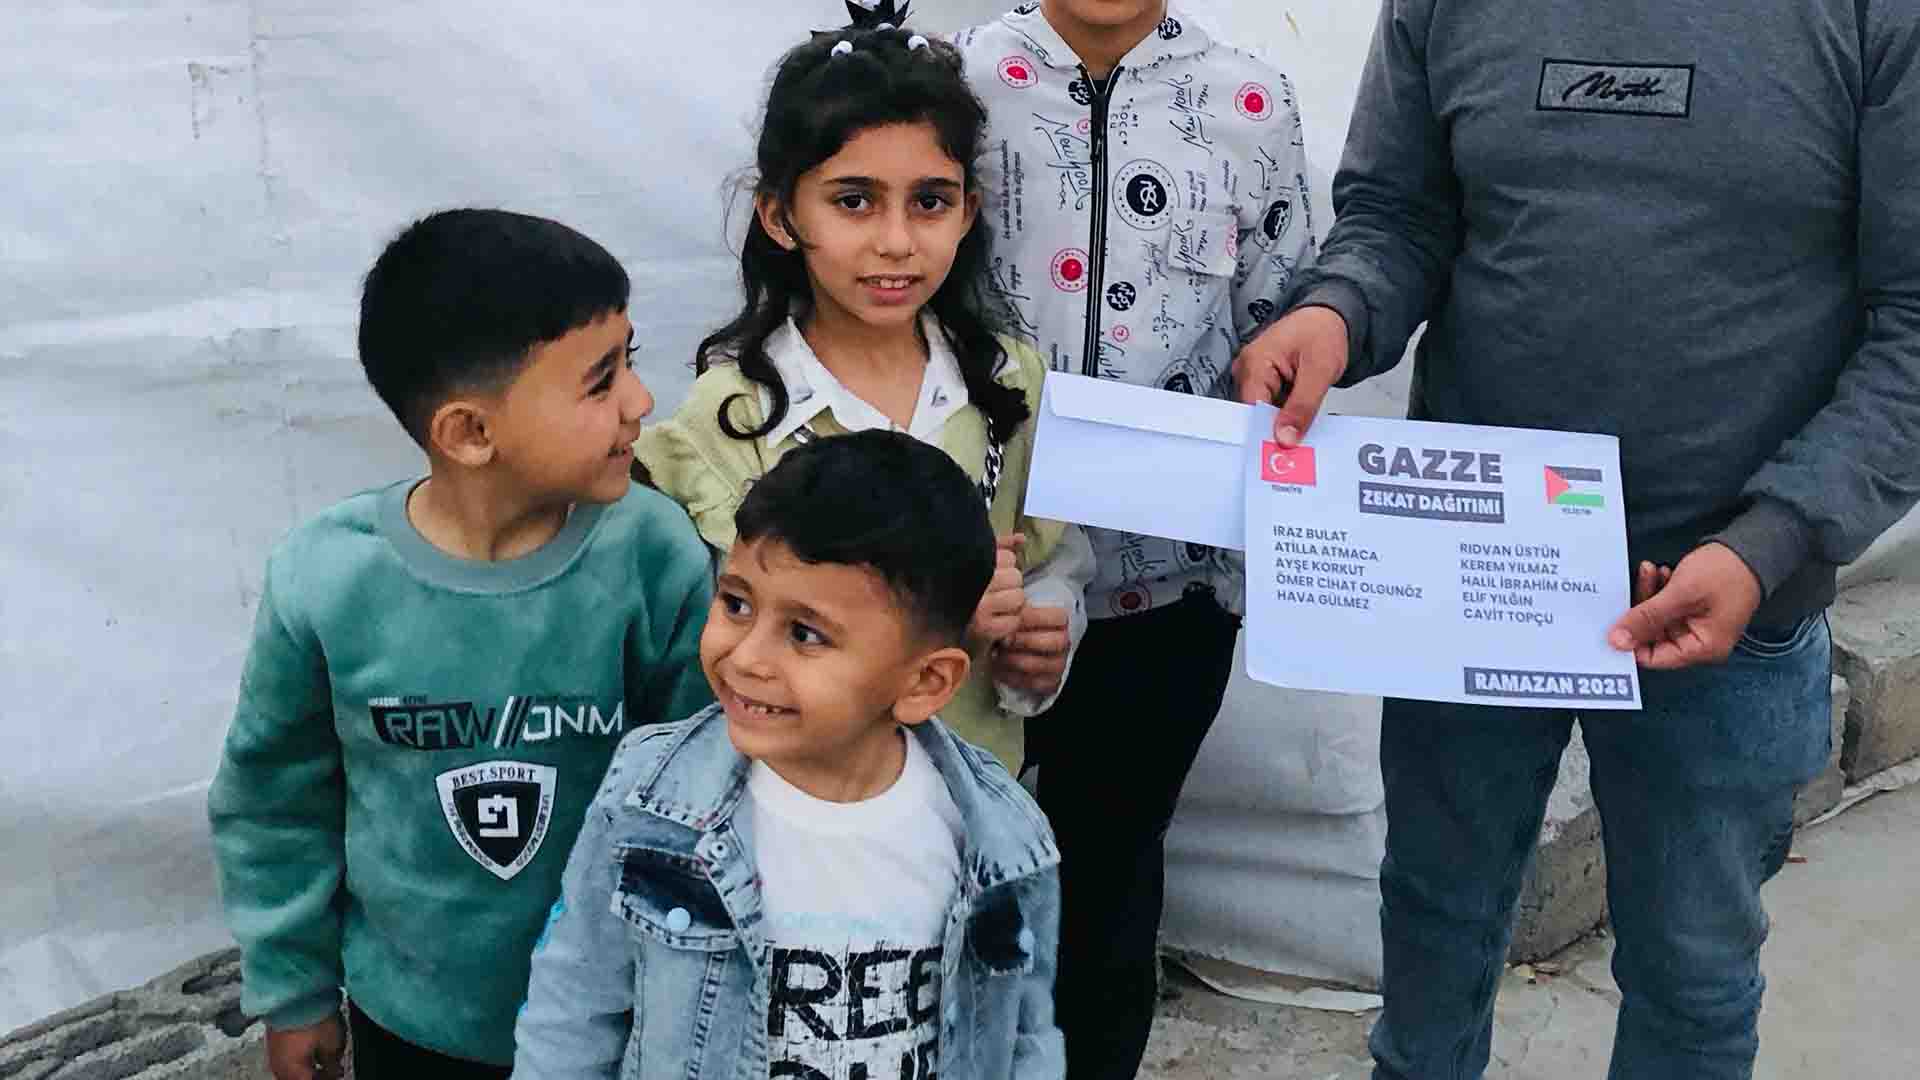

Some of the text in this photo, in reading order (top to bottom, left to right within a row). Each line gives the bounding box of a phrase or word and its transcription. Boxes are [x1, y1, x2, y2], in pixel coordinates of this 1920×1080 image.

[1358, 443, 1503, 484] GAZZE
[1362, 490, 1501, 514] ZEKAT DAĞITIMI
[1305, 528, 1348, 542] BULAT
[1321, 545, 1379, 561] ATMACA
[1460, 543, 1512, 556] RIDVAN
[1276, 557, 1365, 576] AYŞE KORKUT
[1460, 560, 1559, 575] KEREM YILMAZ
[1277, 589, 1315, 604] HAVA
[1507, 610, 1554, 627] TOPÇU
[1474, 672, 1629, 697] RAMAZAN 2025
[489, 767, 536, 781] SPORT
